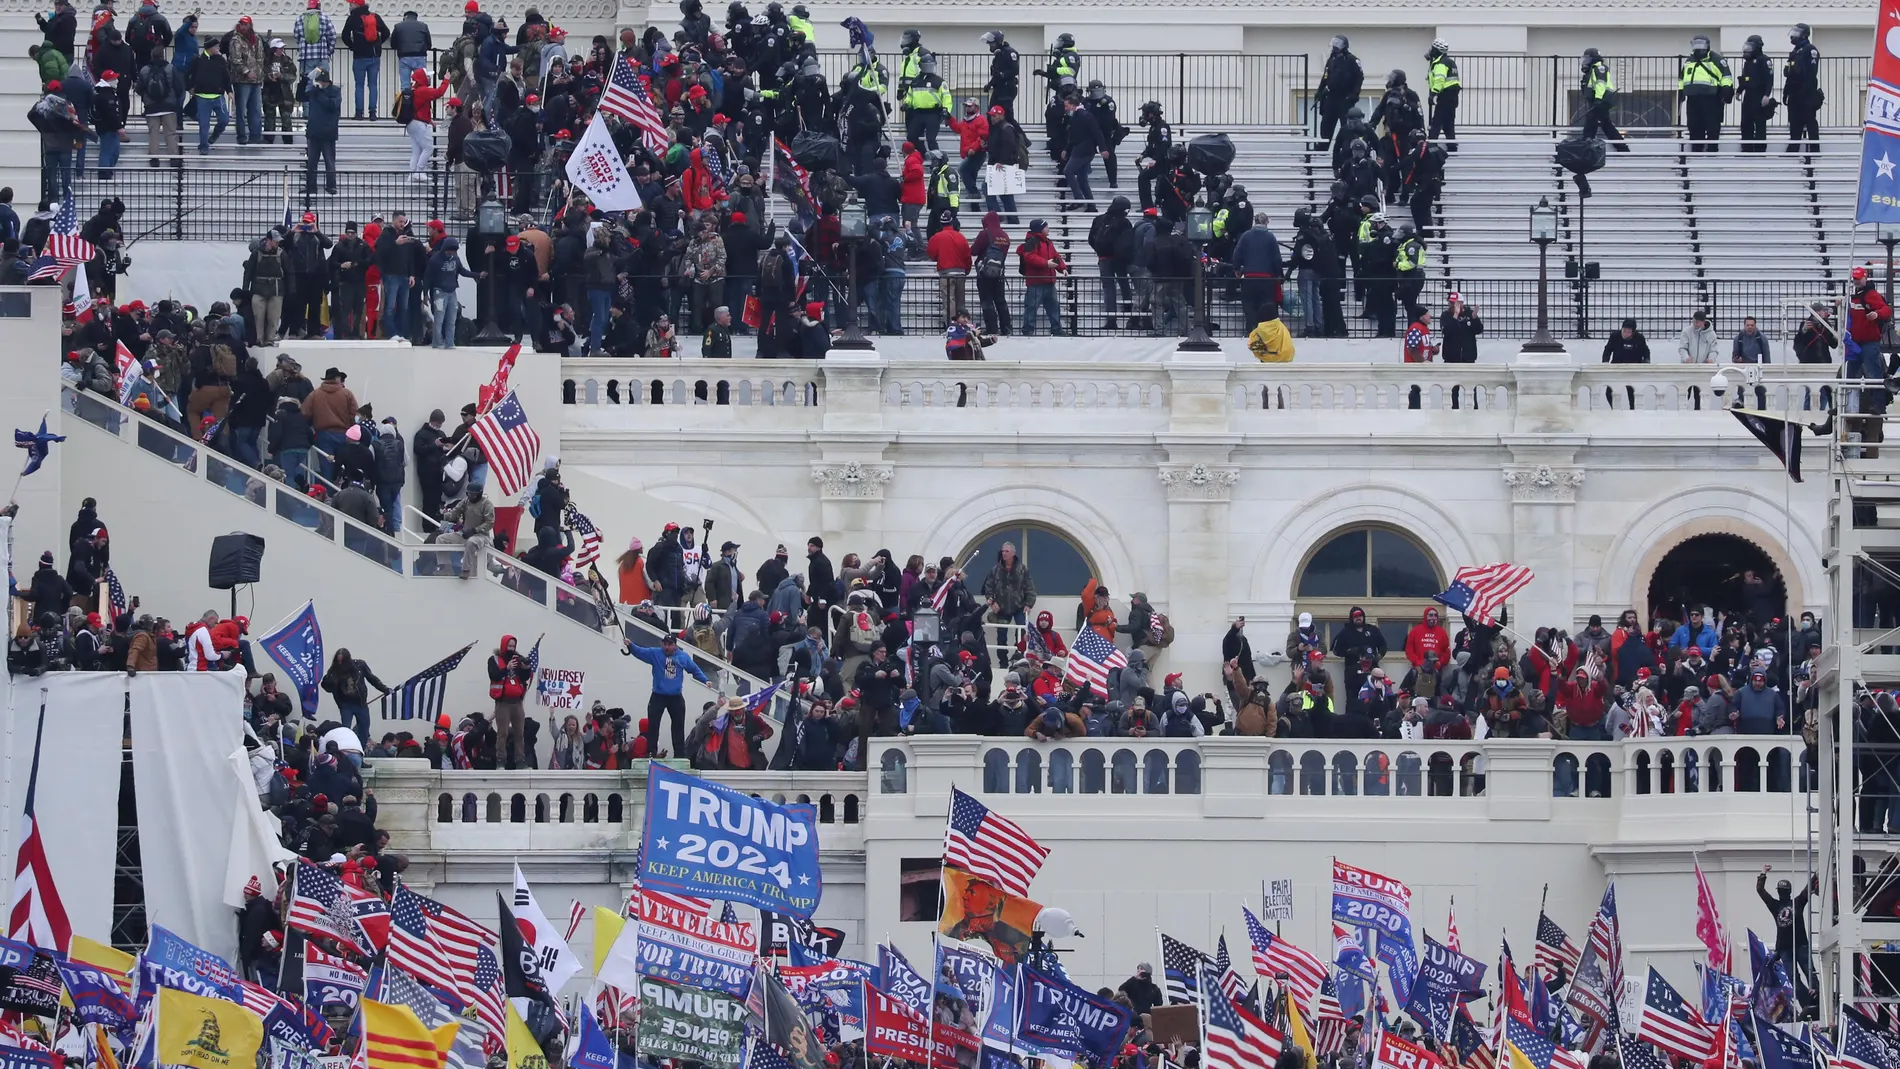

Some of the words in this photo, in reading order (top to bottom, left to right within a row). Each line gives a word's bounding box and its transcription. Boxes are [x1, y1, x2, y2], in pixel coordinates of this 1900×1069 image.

[587, 155, 608, 183] ARMY
[594, 150, 615, 181] TOTO'S
[276, 644, 297, 666] KEEPING
[294, 661, 310, 684] AMERIC
[547, 680, 564, 688] FOR
[553, 669, 585, 683] JERSEY
[542, 695, 550, 706] NO
[554, 696, 572, 708] JOE
[660, 779, 808, 854] TRUMP
[676, 834, 793, 889] 2024
[647, 861, 690, 878] KEEP
[692, 870, 757, 890] AMERICA
[762, 882, 815, 909] TRUMP!
[1271, 880, 1289, 894] FAIR
[1333, 866, 1410, 903] TRUMP
[1333, 883, 1356, 893] KEEP
[1358, 888, 1393, 905] AMERICA
[640, 895, 755, 947] VETERANS
[1265, 908, 1291, 920] MATTER
[1347, 901, 1402, 932] 2020
[638, 924, 667, 939] KEEP
[669, 933, 715, 955] AMERICA
[804, 949, 819, 960] ALL
[1380, 943, 1397, 955] KEEP
[637, 940, 674, 967] FOR
[679, 952, 744, 985] TRUMP
[329, 970, 339, 979] NO
[891, 980, 920, 1008] 2020
[1034, 982, 1118, 1031] TRUMP
[1413, 1000, 1426, 1012] EEP
[907, 1022, 918, 1031] IS
[993, 1023, 1010, 1035] KEEP
[1030, 1024, 1049, 1034] KEEP
[221, 1057, 230, 1066] ME
[585, 1052, 607, 1062] KEEP
